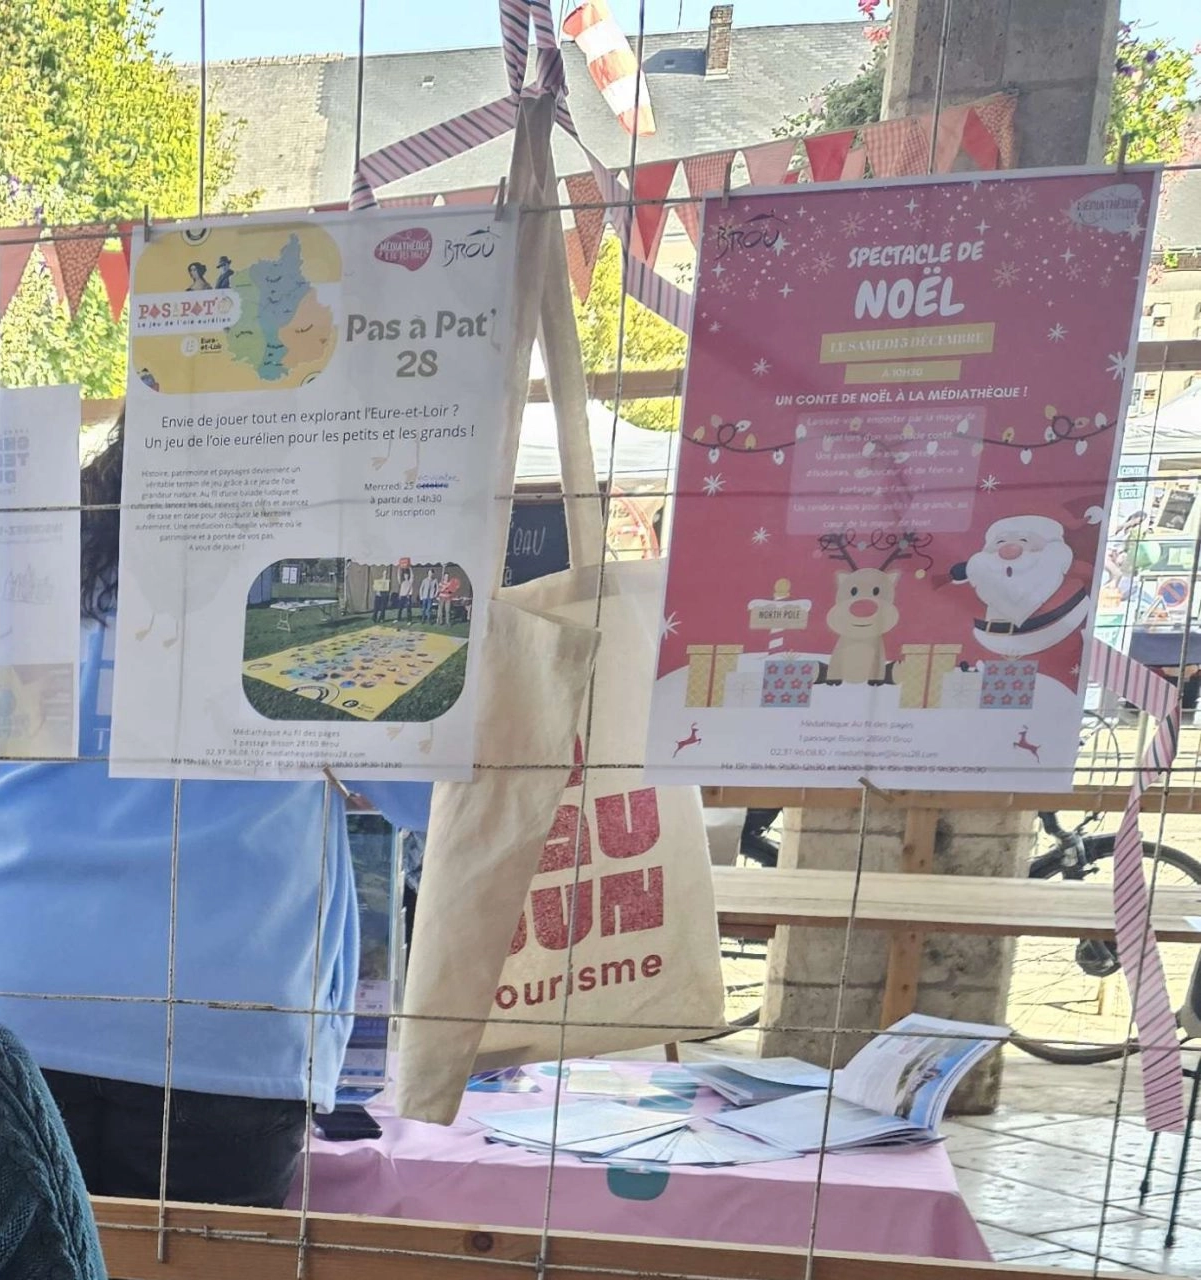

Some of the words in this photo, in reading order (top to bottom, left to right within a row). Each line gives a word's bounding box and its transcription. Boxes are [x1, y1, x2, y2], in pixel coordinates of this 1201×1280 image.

[444, 240, 494, 267] BROU
[847, 241, 950, 268] SPECTACLE
[956, 240, 985, 263] DE
[854, 266, 965, 319] NOËL
[347, 313, 402, 342] Pas
[409, 315, 427, 339] à
[435, 308, 497, 337] Pat'
[849, 339, 898, 352] SAMEDI
[910, 332, 984, 347] DÉCEMBRE
[396, 350, 438, 378] 28
[775, 395, 794, 406] UN
[796, 394, 838, 405] CONTE
[841, 393, 857, 404] DE
[860, 389, 892, 403] NOËL
[896, 387, 906, 401] À
[909, 389, 924, 401] LA
[927, 385, 1019, 400] MÉDIATHÈQUE
[162, 415, 193, 428] Envie
[197, 415, 213, 427] de
[215, 414, 249, 429] jouer
[252, 412, 277, 424] tout
[281, 413, 296, 423] en
[300, 408, 361, 426] explorant
[364, 405, 449, 421] l'Eure-et-Loir
[452, 404, 458, 417] ?
[145, 437, 161, 449] Un
[164, 436, 184, 452] jeu
[187, 435, 203, 448] de
[206, 433, 230, 447] l'oie
[234, 432, 284, 445] eurélien
[288, 433, 318, 448] pour
[322, 430, 339, 443] les
[343, 428, 378, 444] petits
[382, 428, 395, 439] et
[399, 427, 417, 439] les
[420, 425, 467, 442] grands
[470, 425, 475, 437] !
[365, 483, 401, 491] Mercredi
[404, 482, 414, 490] 25
[370, 496, 375, 504] à
[378, 495, 401, 504] partir
[375, 509, 389, 517] Sur
[392, 508, 435, 517] inscription
[758, 609, 781, 620] NORTH
[495, 953, 663, 1010] ourisme
